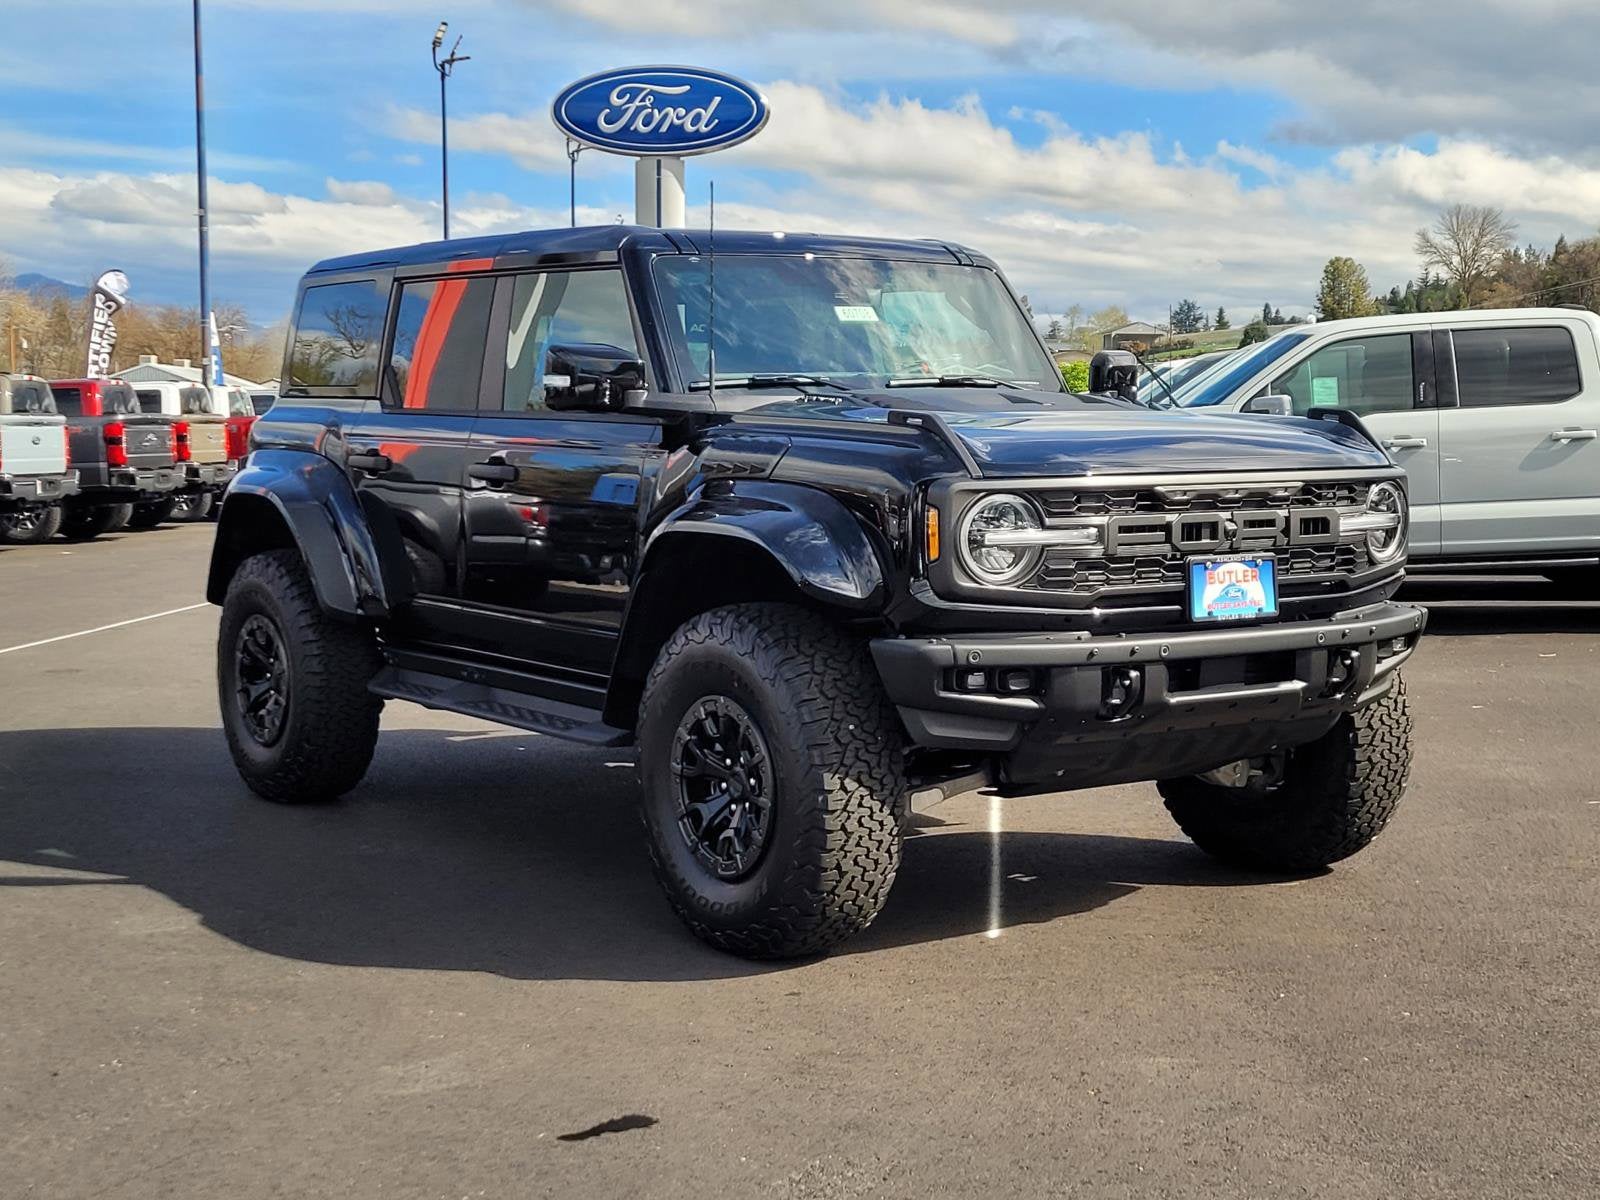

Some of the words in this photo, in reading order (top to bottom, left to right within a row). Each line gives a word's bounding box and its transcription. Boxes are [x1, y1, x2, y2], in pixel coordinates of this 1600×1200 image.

[597, 83, 722, 134] Ford
[1107, 508, 1340, 554] FORD
[1207, 569, 1258, 584] BUTLER
